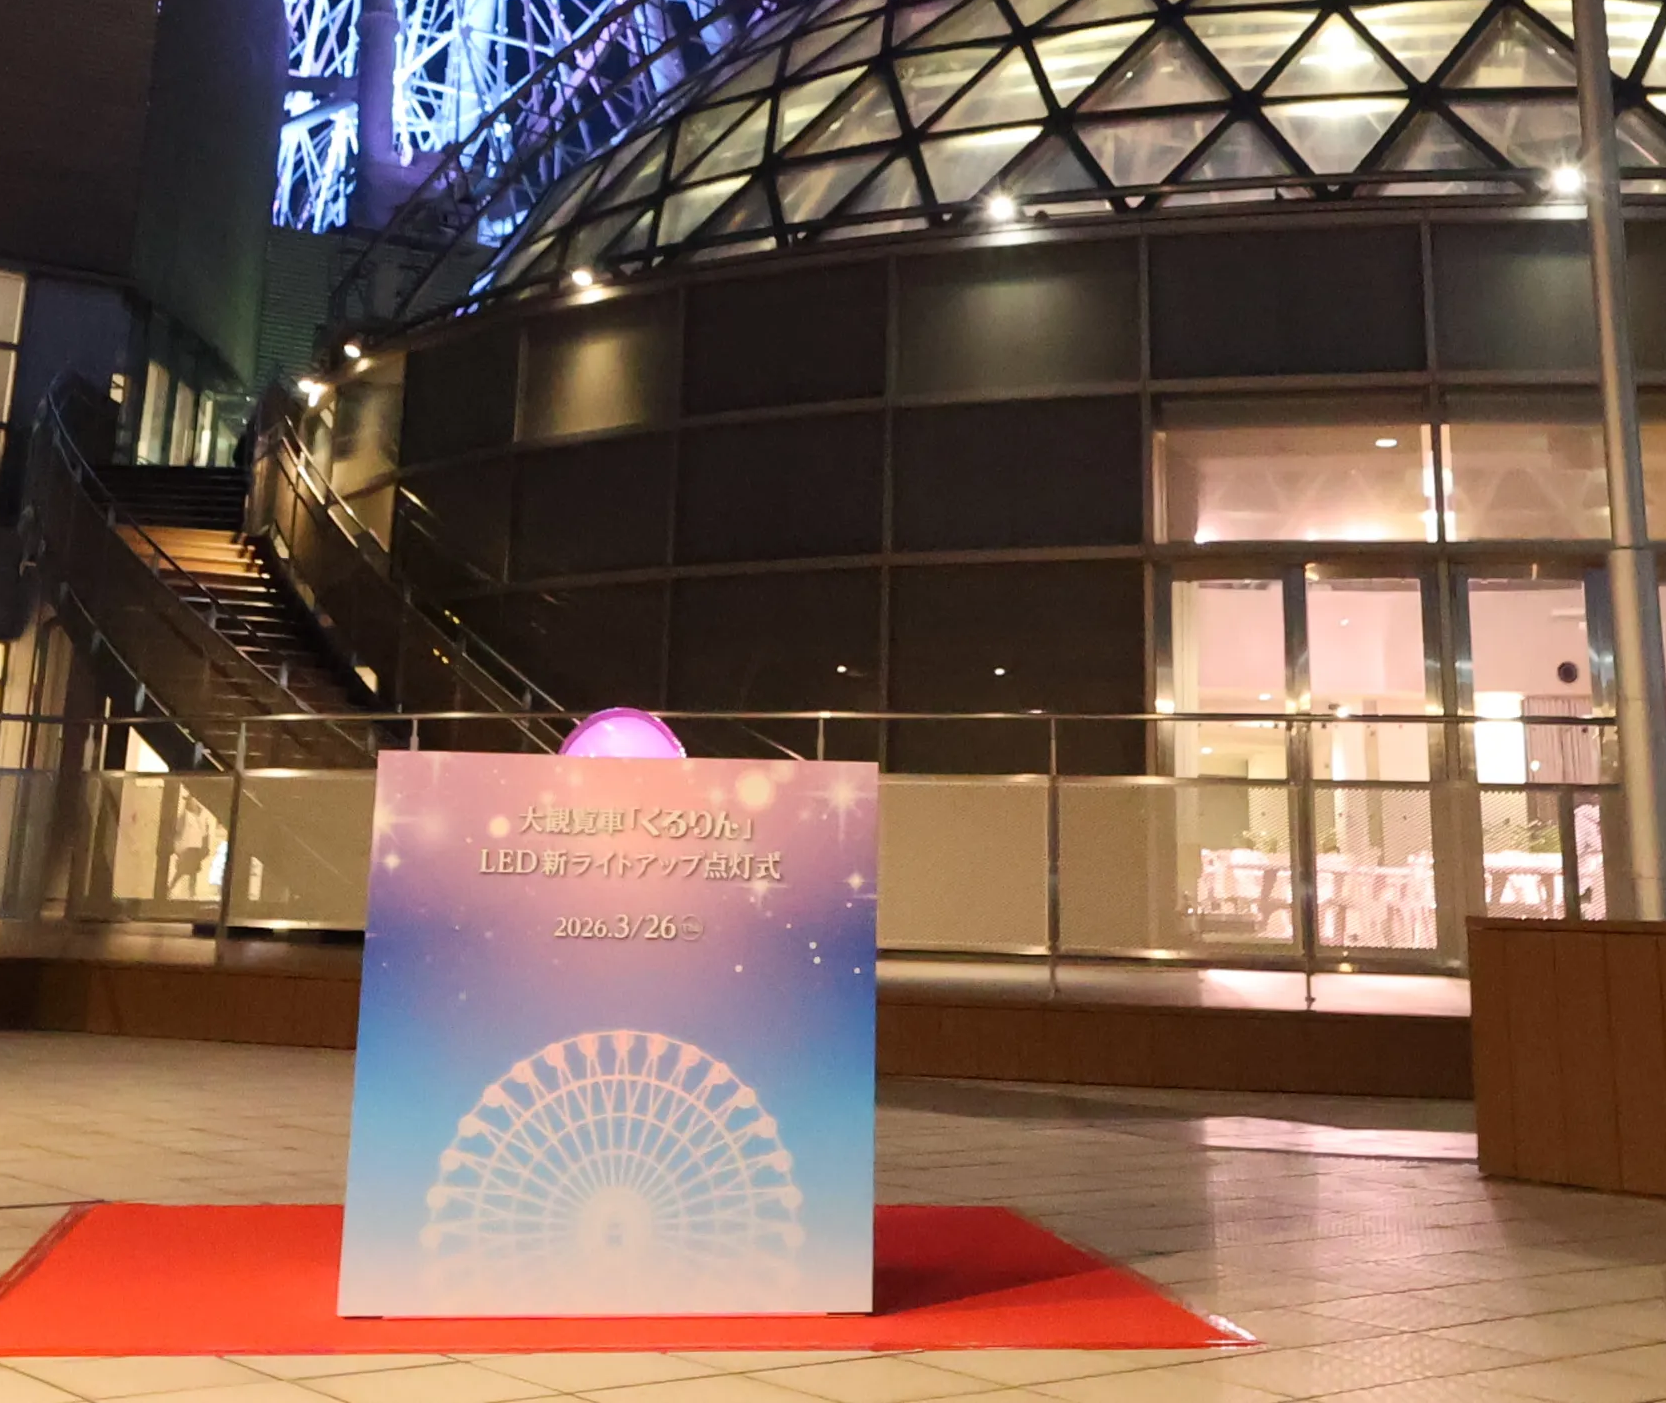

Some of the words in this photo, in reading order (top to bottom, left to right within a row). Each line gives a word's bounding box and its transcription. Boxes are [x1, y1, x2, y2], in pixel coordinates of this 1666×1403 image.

[519, 805, 753, 841] 大観覧車「くるりん」
